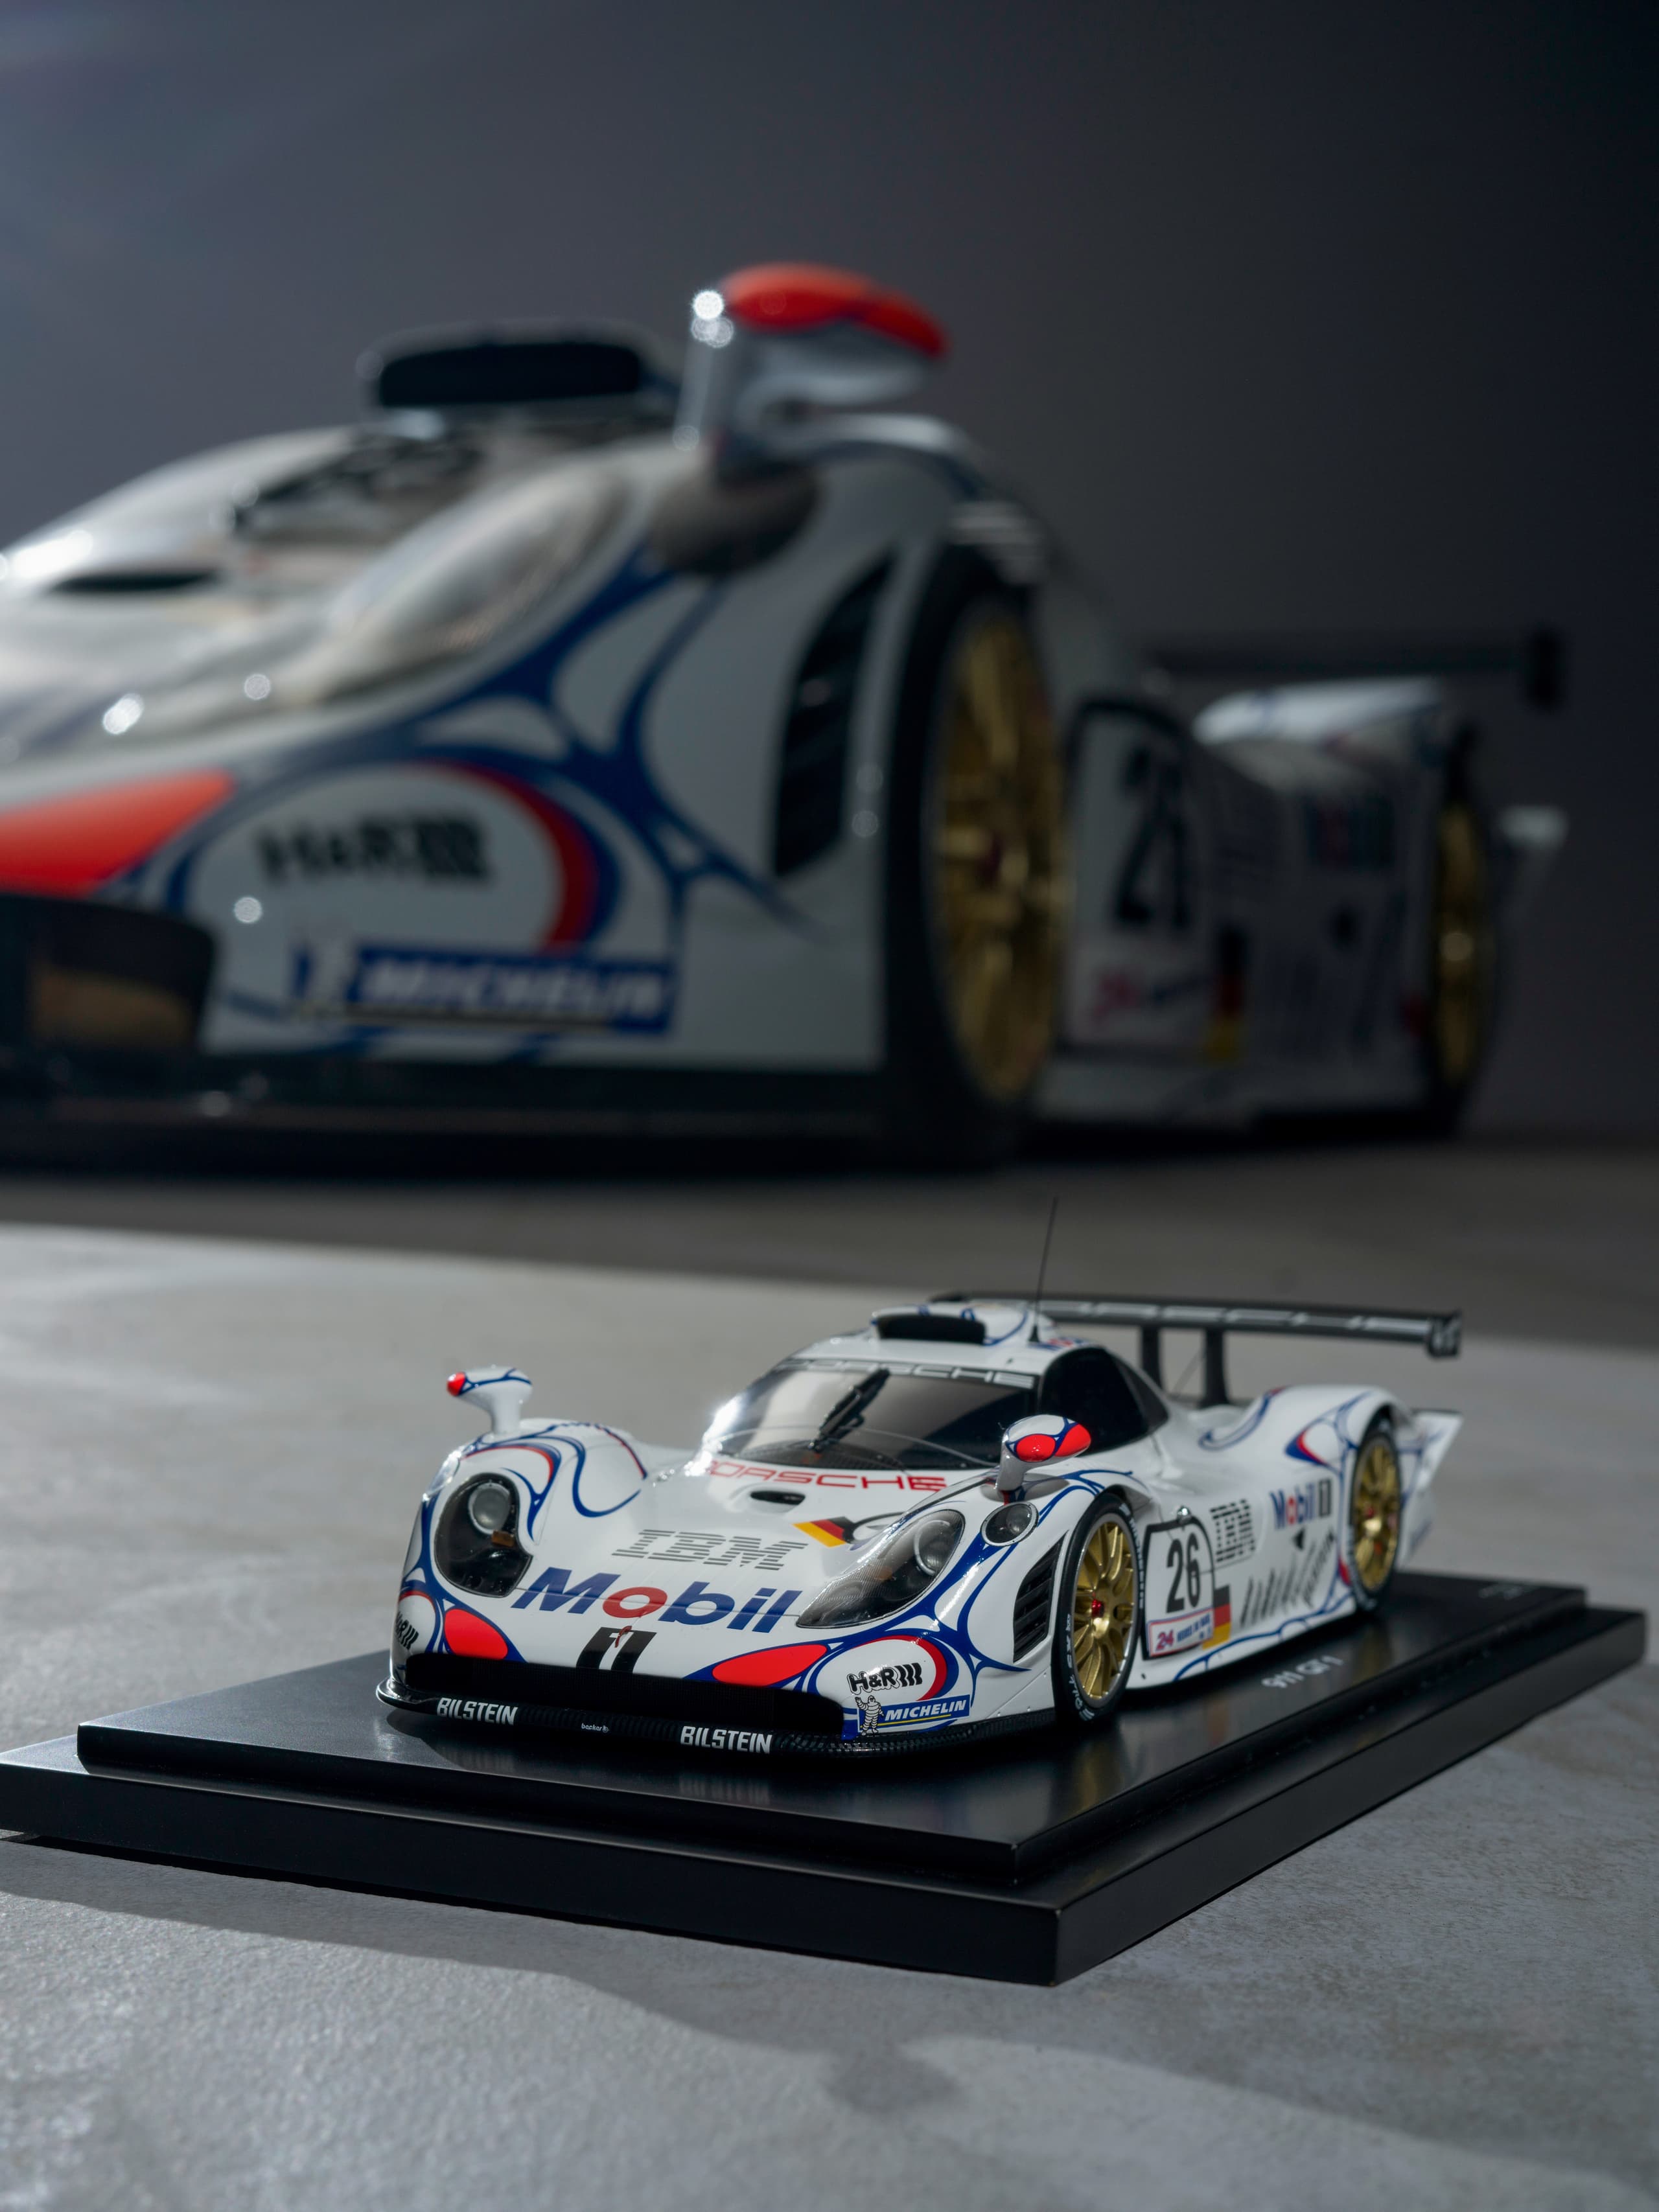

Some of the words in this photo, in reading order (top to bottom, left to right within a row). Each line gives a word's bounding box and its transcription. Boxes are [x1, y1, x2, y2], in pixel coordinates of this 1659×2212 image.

[709, 1460, 947, 1492] ORSCHE
[1270, 1482, 1316, 1530] Mobil
[612, 1530, 808, 1571] IBM
[1166, 1532, 1200, 1613] 26
[511, 1567, 802, 1633] Mobil
[1155, 1630, 1174, 1652] 24
[1261, 1670, 1305, 1688] 911
[437, 1698, 518, 1725] BILSTEIN
[885, 1700, 966, 1722] MICHELIN
[581, 1723, 602, 1731] becker
[680, 1726, 772, 1754] BILSTEIN
